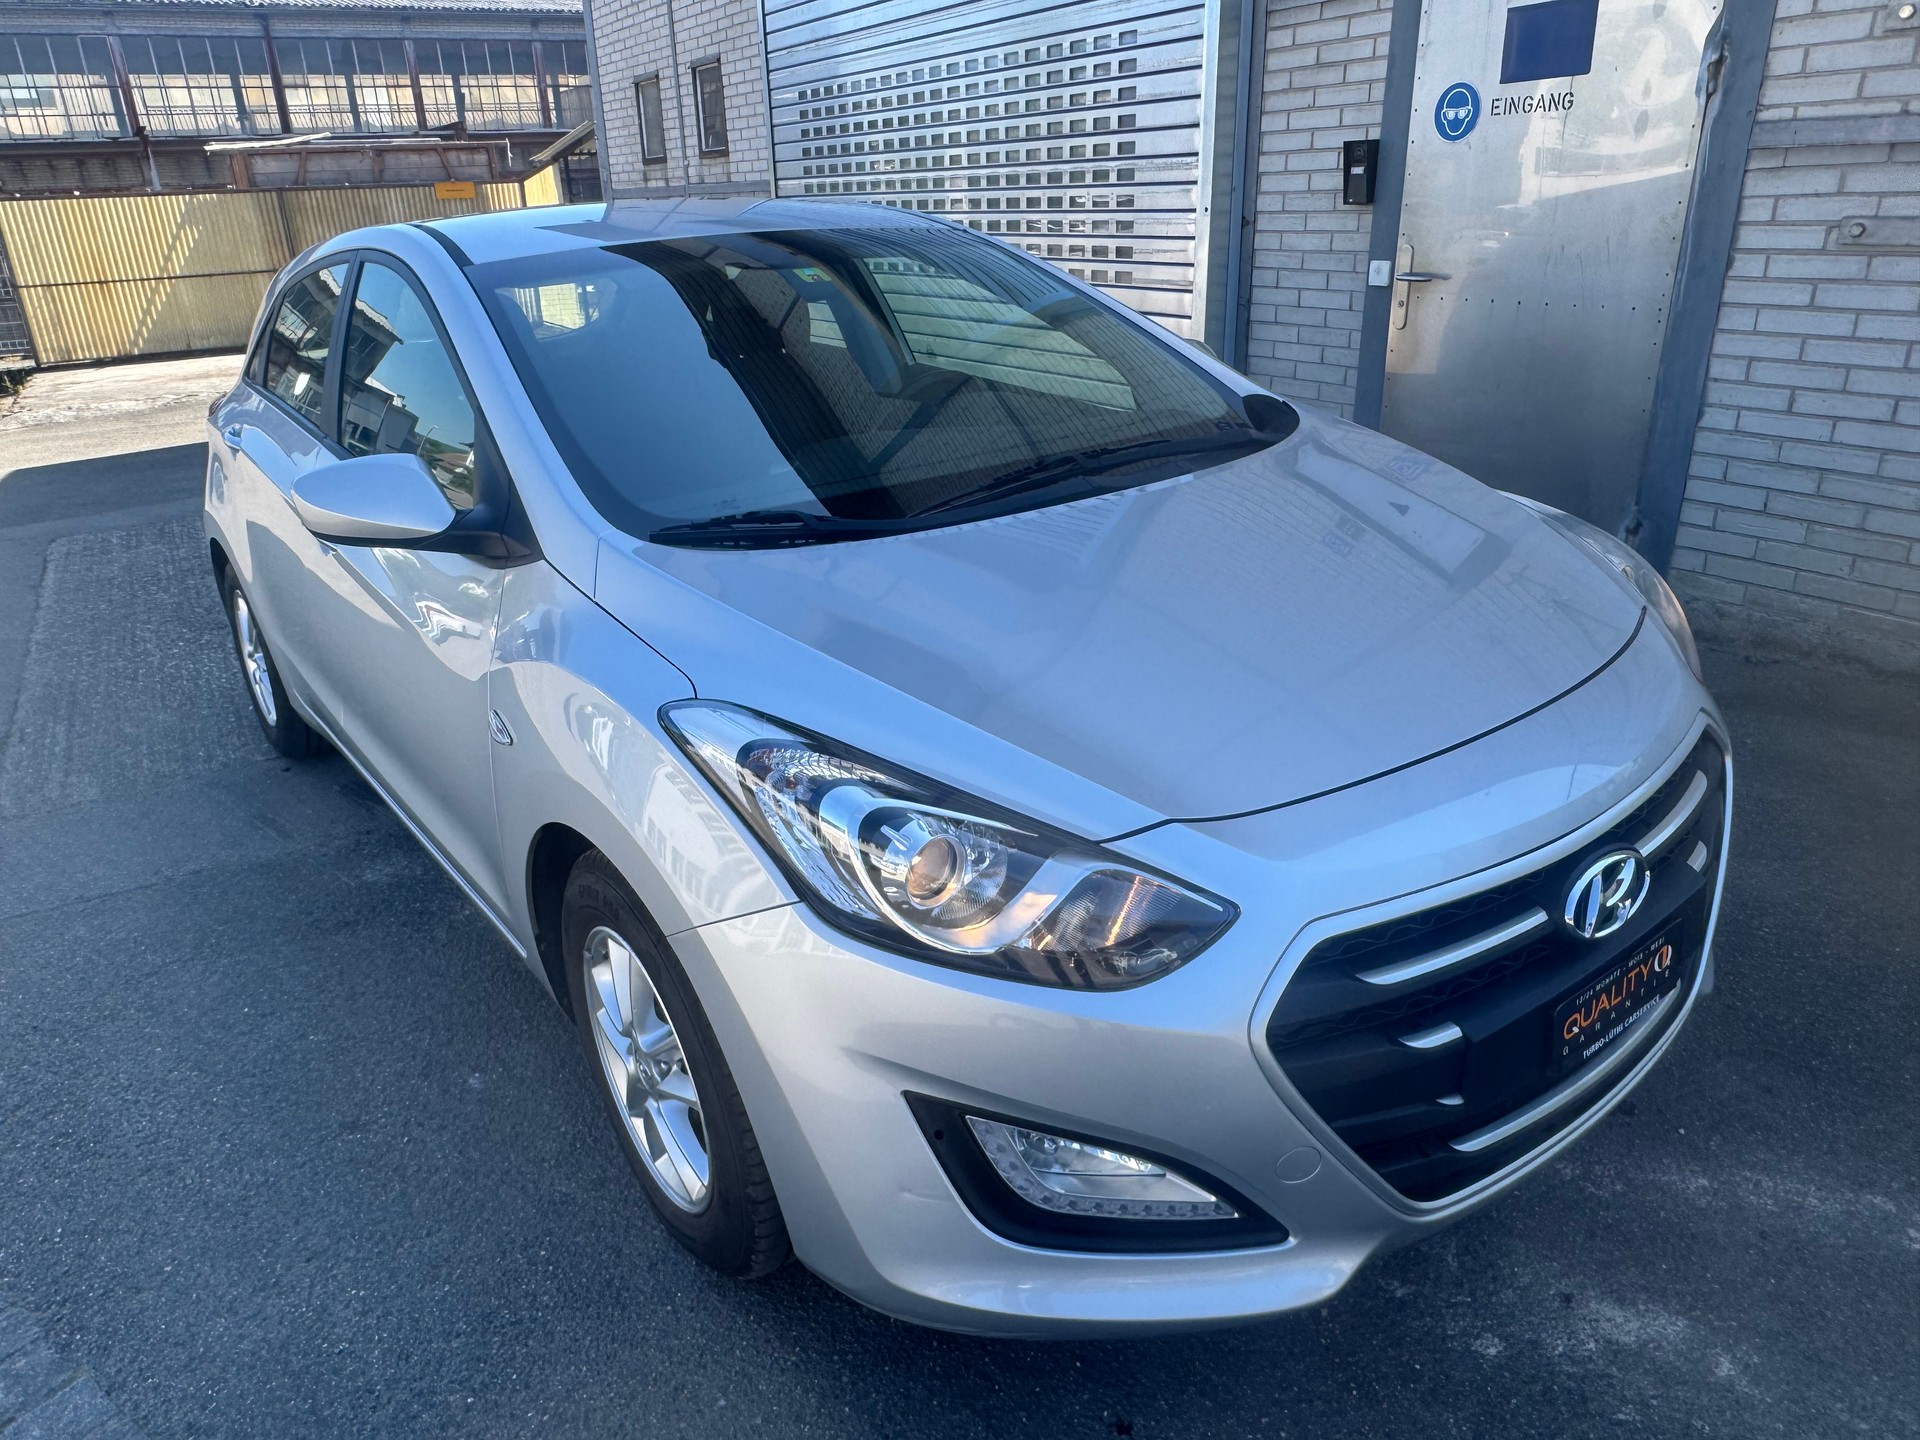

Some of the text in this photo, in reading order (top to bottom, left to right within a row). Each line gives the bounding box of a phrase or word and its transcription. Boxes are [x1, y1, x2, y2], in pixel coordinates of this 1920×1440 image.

[1490, 91, 1574, 116] EINGANG
[1595, 968, 1621, 991] MONATE
[1628, 952, 1643, 967] MOIS
